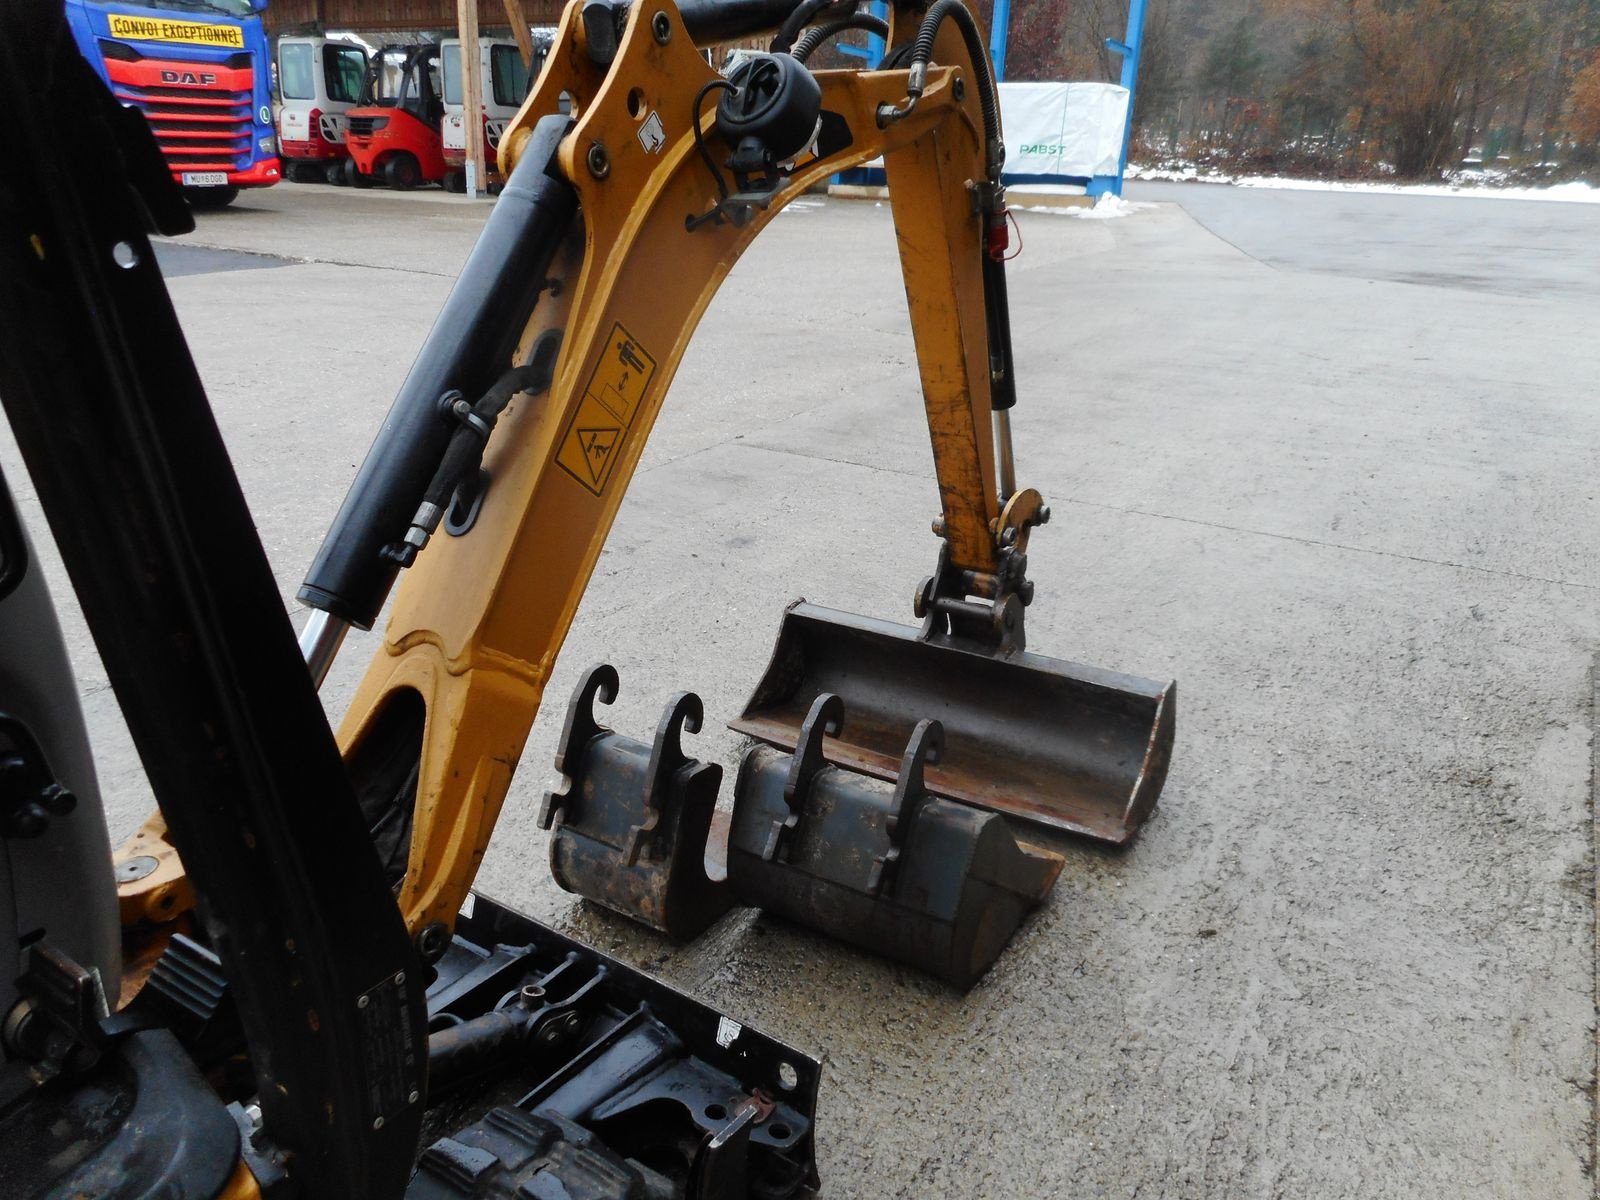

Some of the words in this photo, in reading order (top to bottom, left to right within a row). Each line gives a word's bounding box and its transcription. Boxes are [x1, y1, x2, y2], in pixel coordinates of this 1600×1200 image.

[113, 17, 159, 36] CONVOI
[162, 23, 240, 45] EXCEPTIONNEL
[160, 70, 217, 86] DAF
[1019, 144, 1067, 155] PABST
